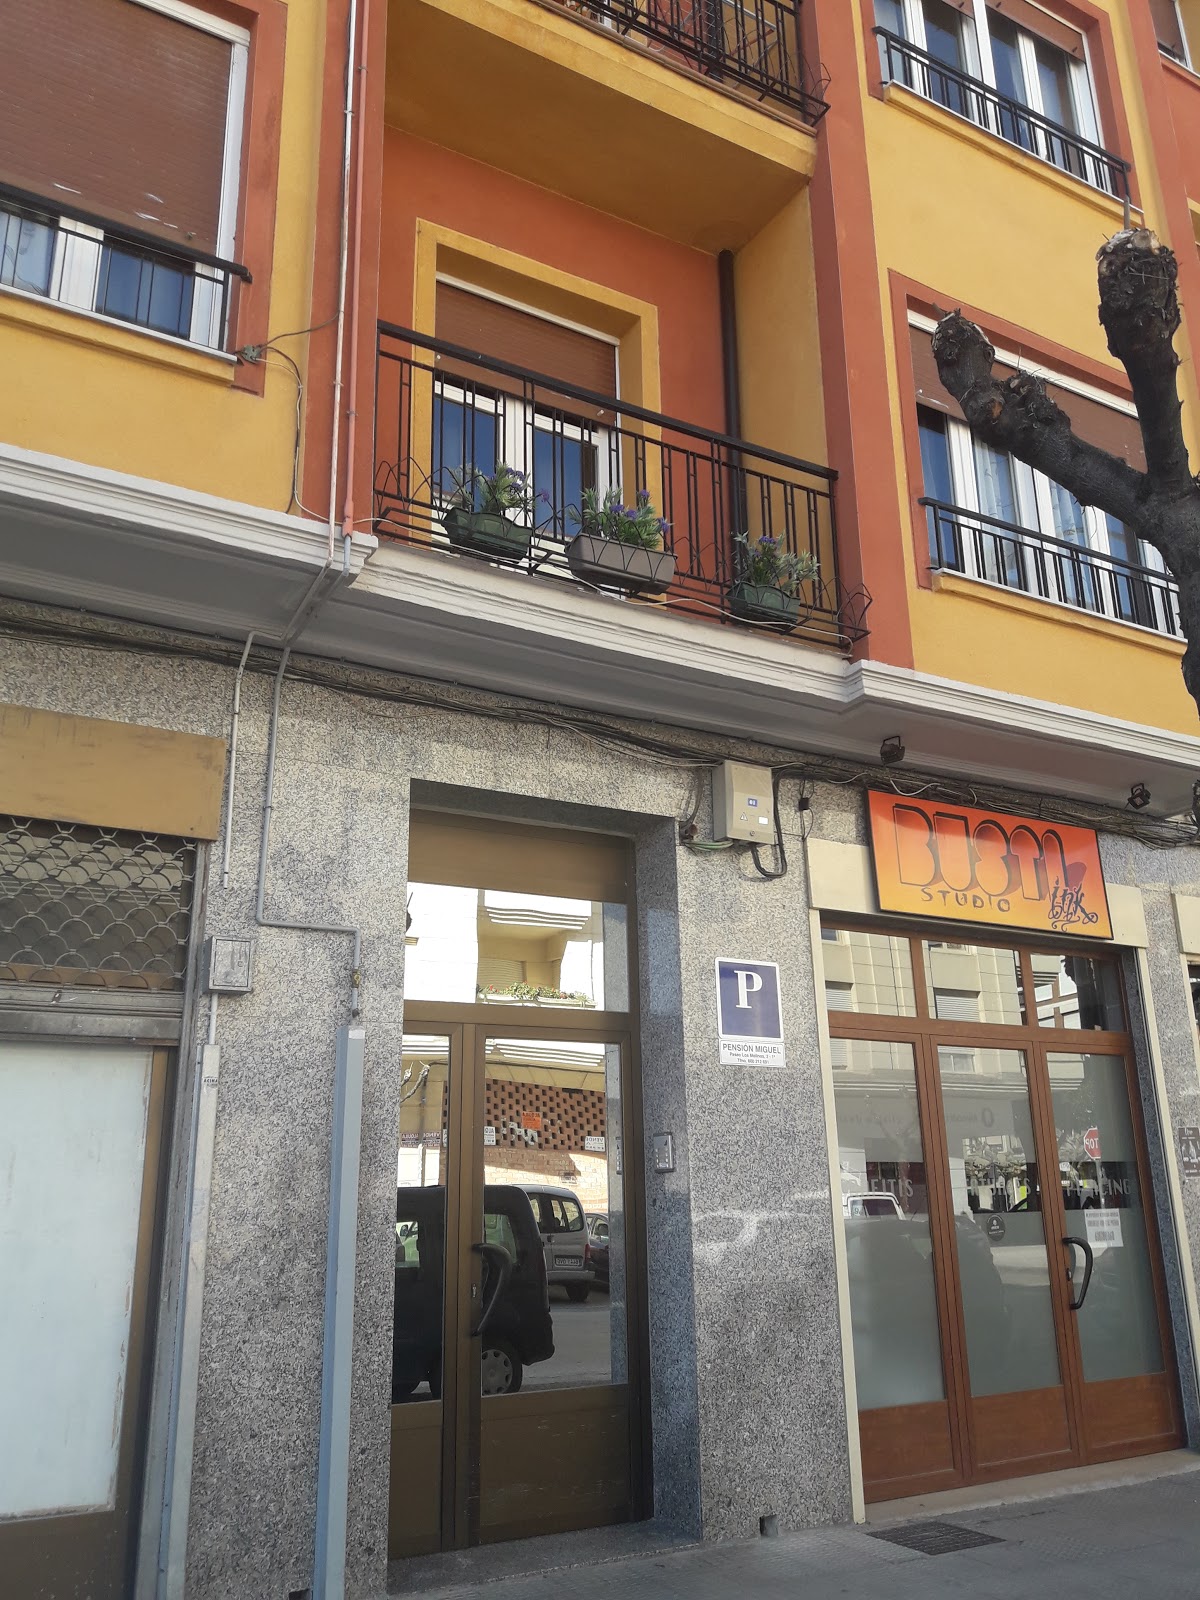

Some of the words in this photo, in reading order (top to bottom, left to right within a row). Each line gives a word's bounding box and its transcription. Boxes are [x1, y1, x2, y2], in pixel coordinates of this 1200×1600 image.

[920, 887, 1011, 912] STUDIO
[733, 970, 763, 1009] P
[722, 1043, 754, 1053] PENSIÓN
[755, 1045, 781, 1054] MIGUEL
